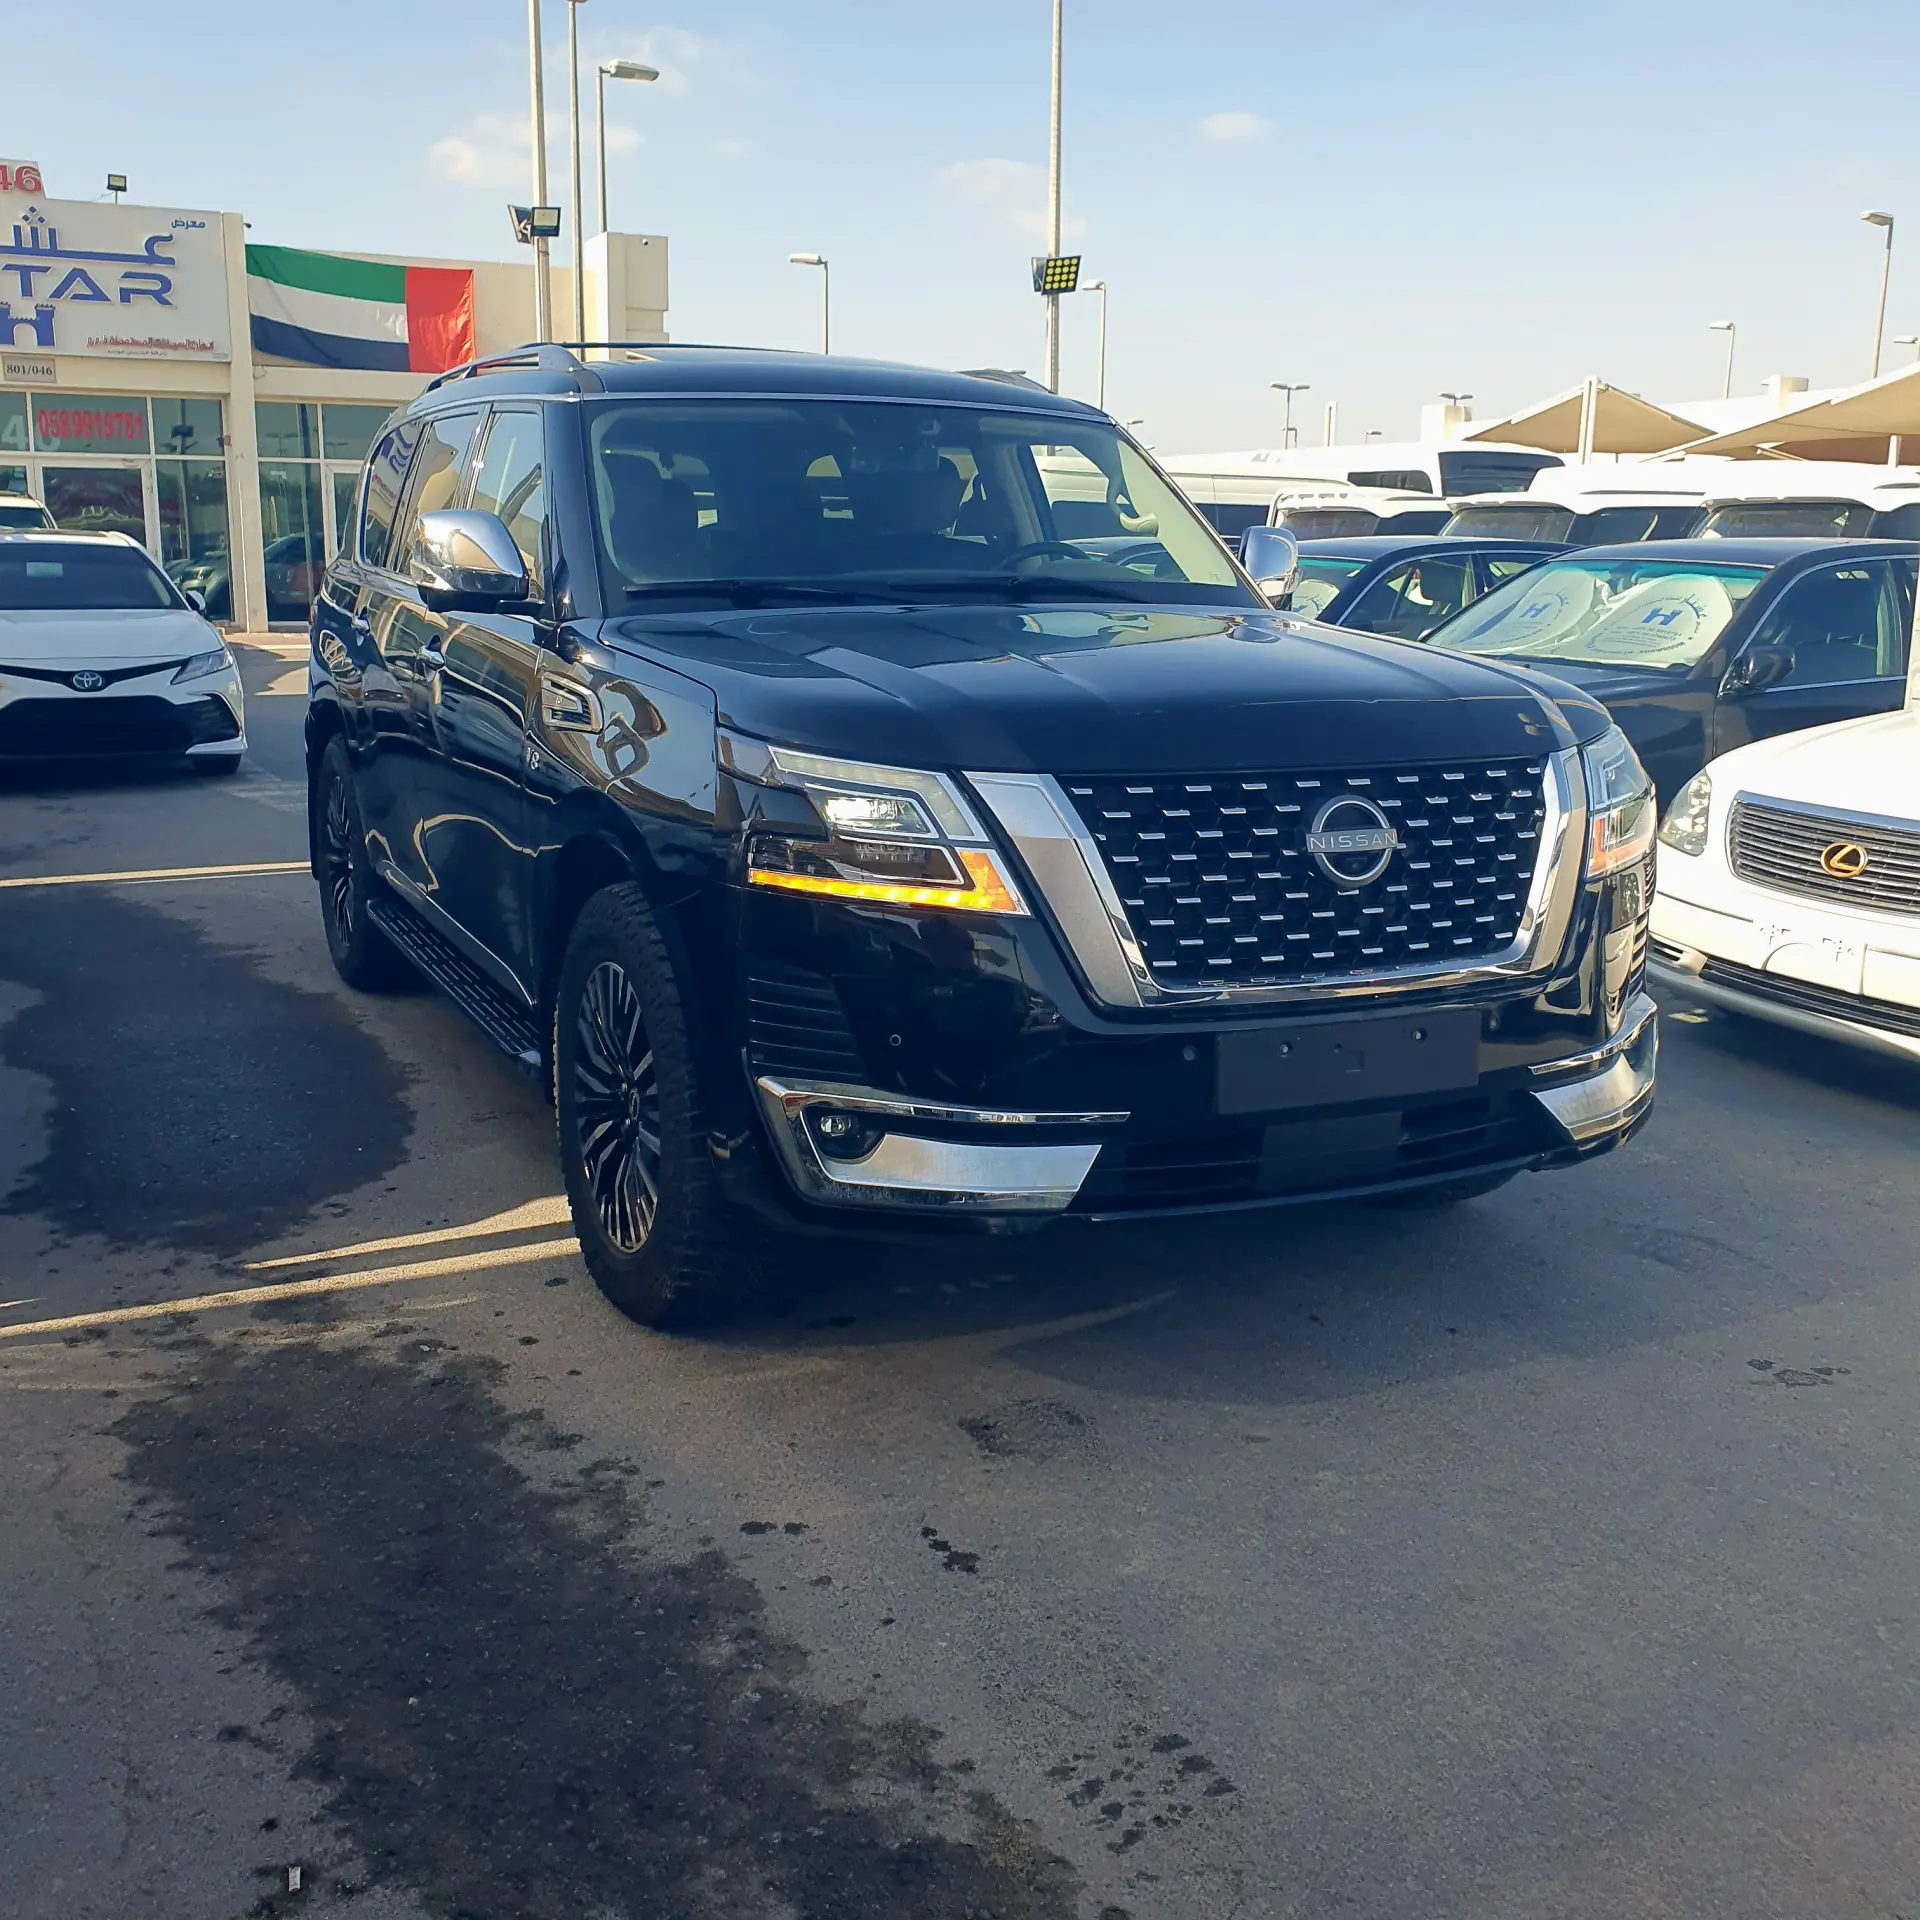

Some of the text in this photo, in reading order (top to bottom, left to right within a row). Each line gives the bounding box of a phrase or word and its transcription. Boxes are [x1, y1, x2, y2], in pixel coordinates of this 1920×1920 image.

[171, 216, 206, 230] معرض
[6, 364, 53, 376] 801/046
[37, 409, 143, 440] 0589919781
[1309, 832, 1397, 850] NISSAN
